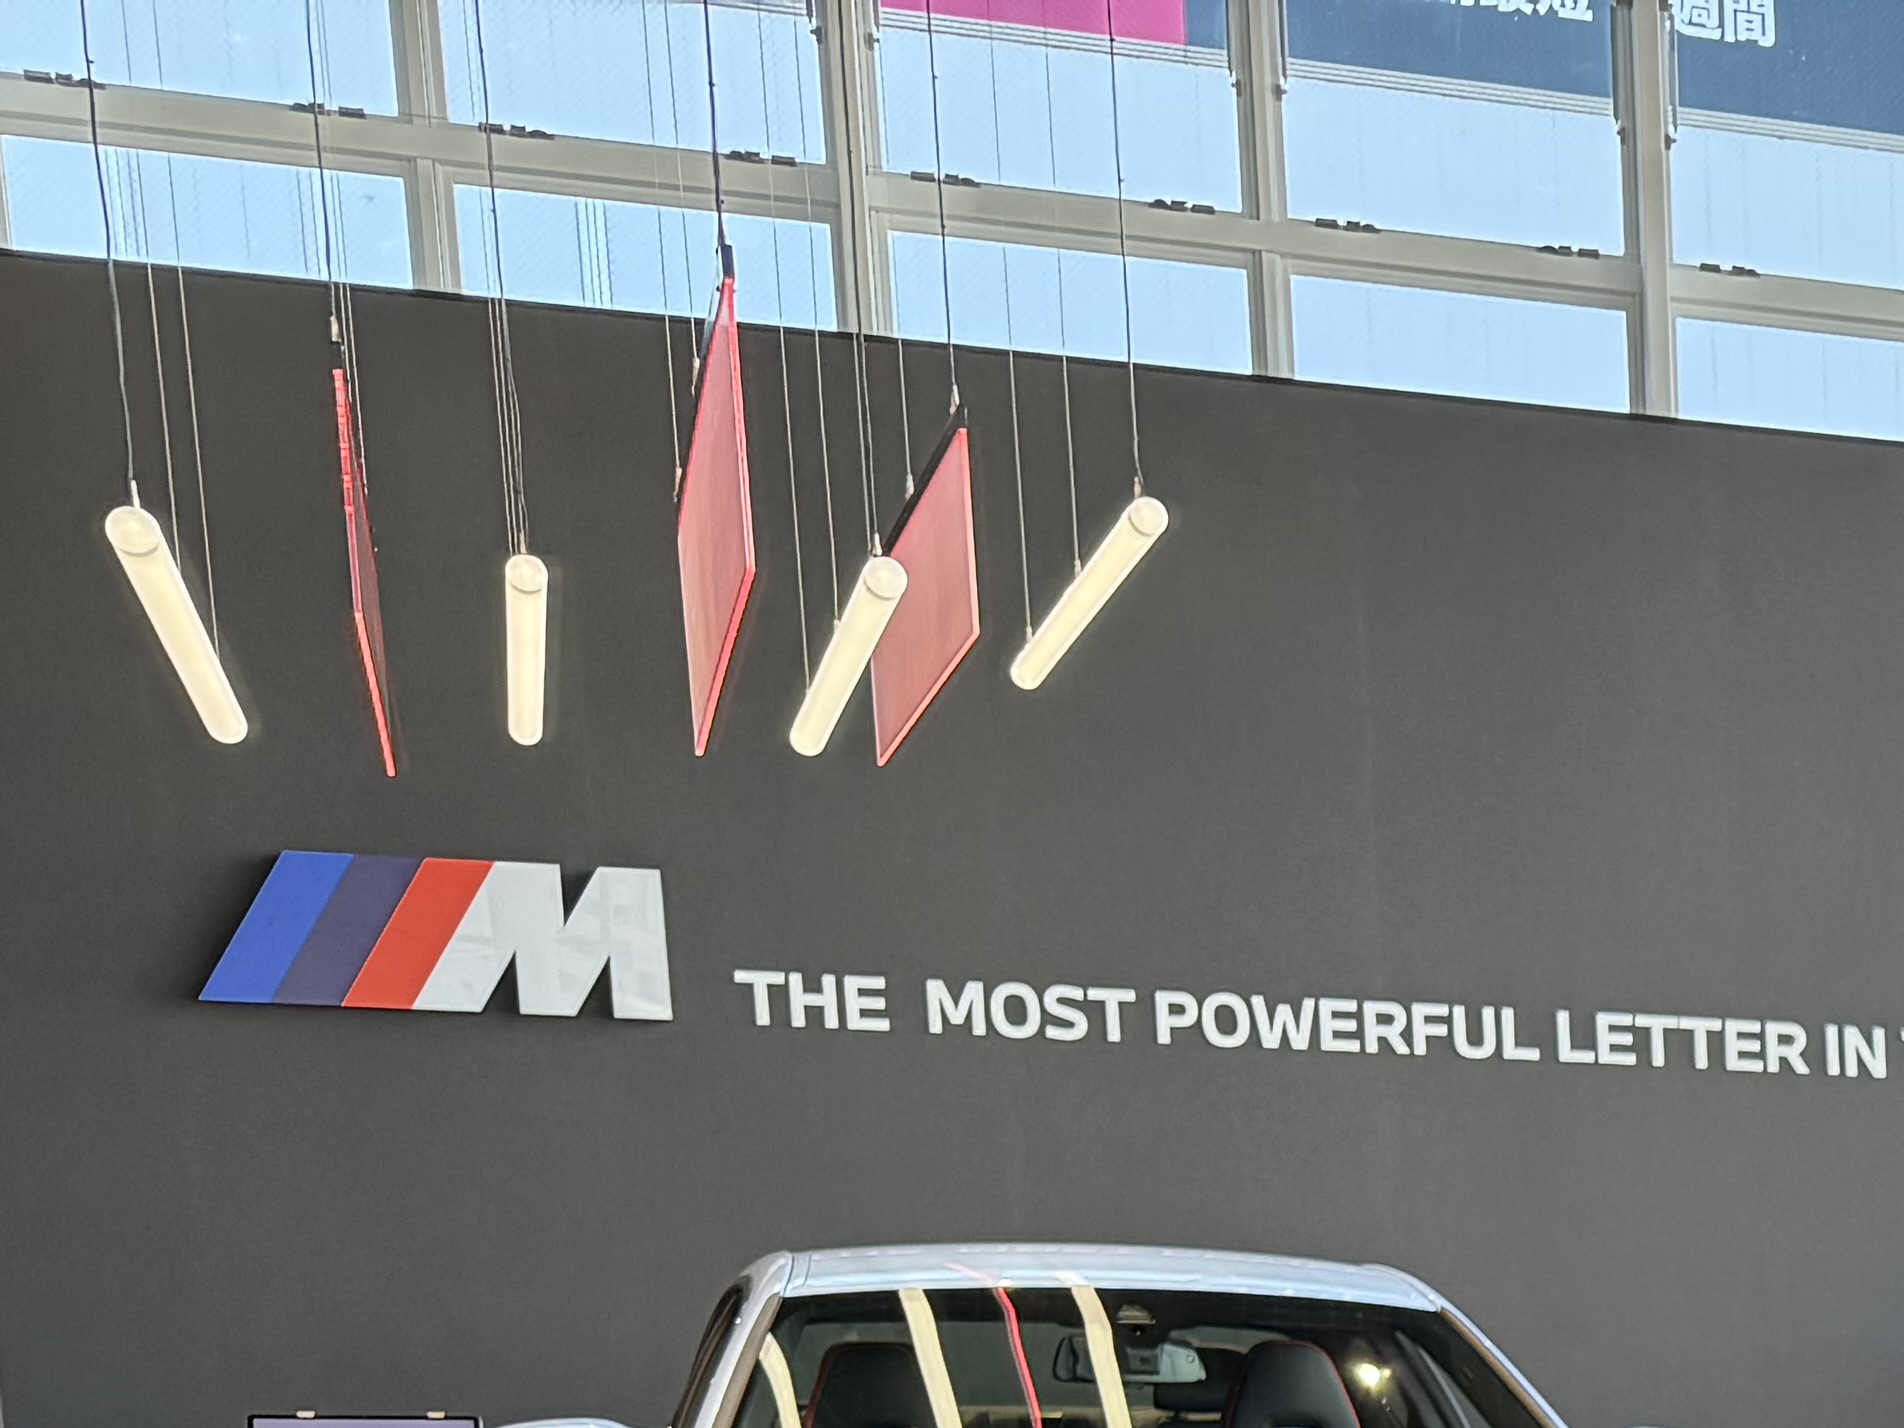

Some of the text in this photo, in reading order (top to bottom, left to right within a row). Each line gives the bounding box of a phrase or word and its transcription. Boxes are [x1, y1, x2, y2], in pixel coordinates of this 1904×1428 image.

[413, 860, 673, 1021] M
[733, 968, 890, 1032] THE
[925, 978, 1136, 1043] MOST
[1153, 988, 1540, 1062] POWERFUL
[1555, 1009, 1811, 1076] LETTER
[1824, 1022, 1888, 1080] IN
